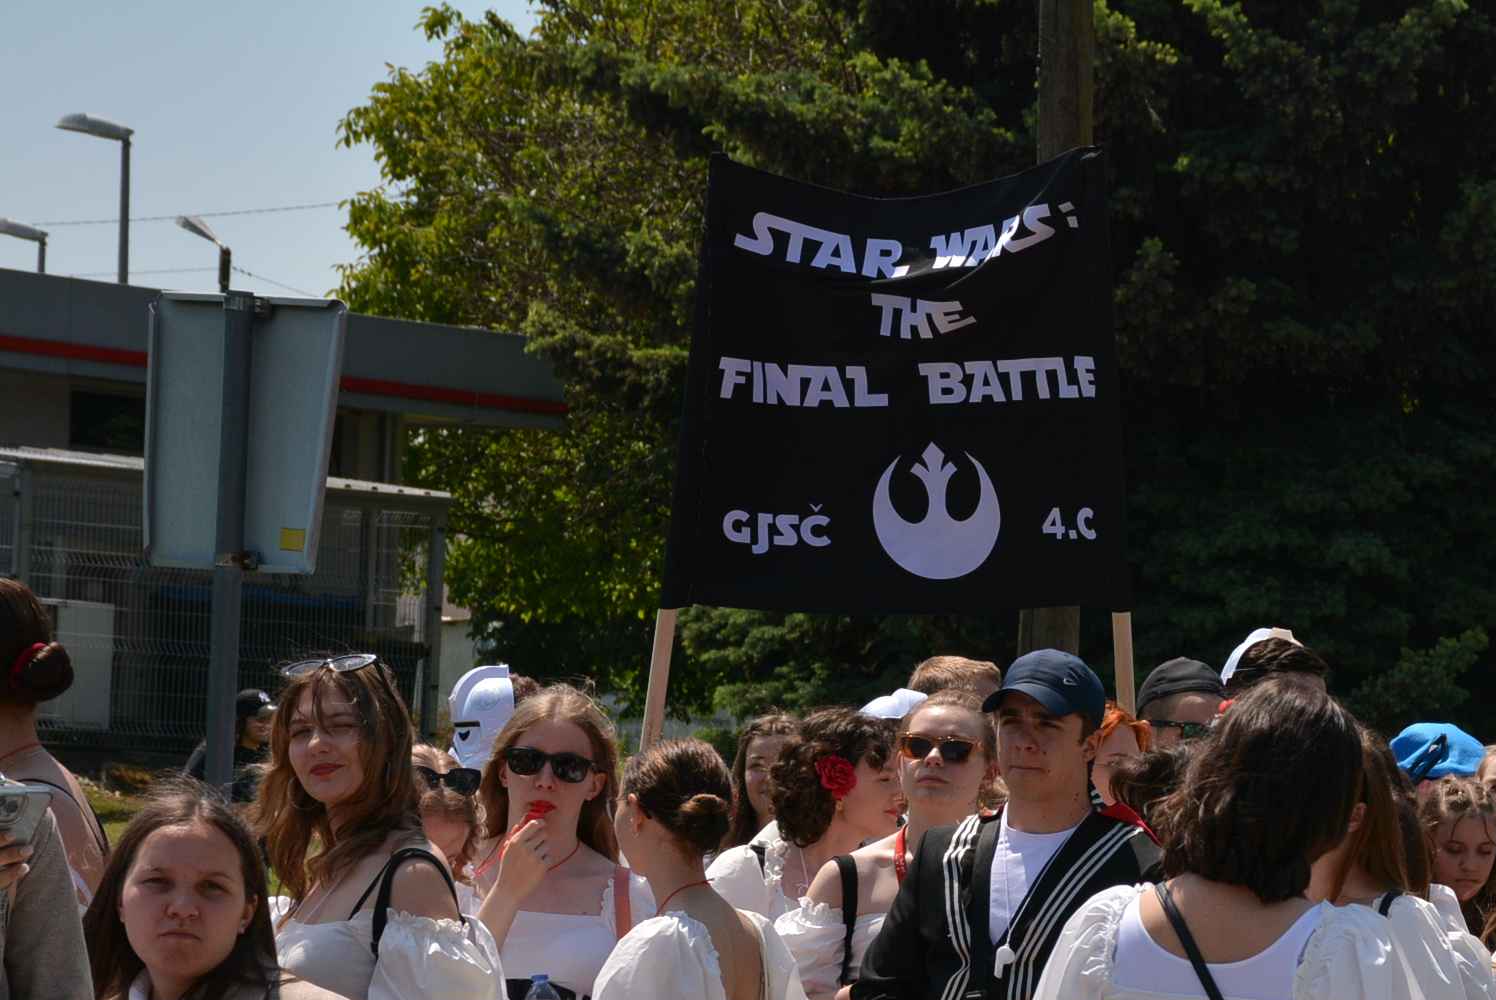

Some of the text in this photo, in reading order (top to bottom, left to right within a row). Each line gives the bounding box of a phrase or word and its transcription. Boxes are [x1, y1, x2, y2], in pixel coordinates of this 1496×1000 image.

[734, 211, 909, 280] STAR
[871, 293, 977, 340] THE
[718, 356, 1096, 408] FINAL BATTLE
[722, 503, 832, 554] GJSČ
[1041, 507, 1097, 541] 4.C
